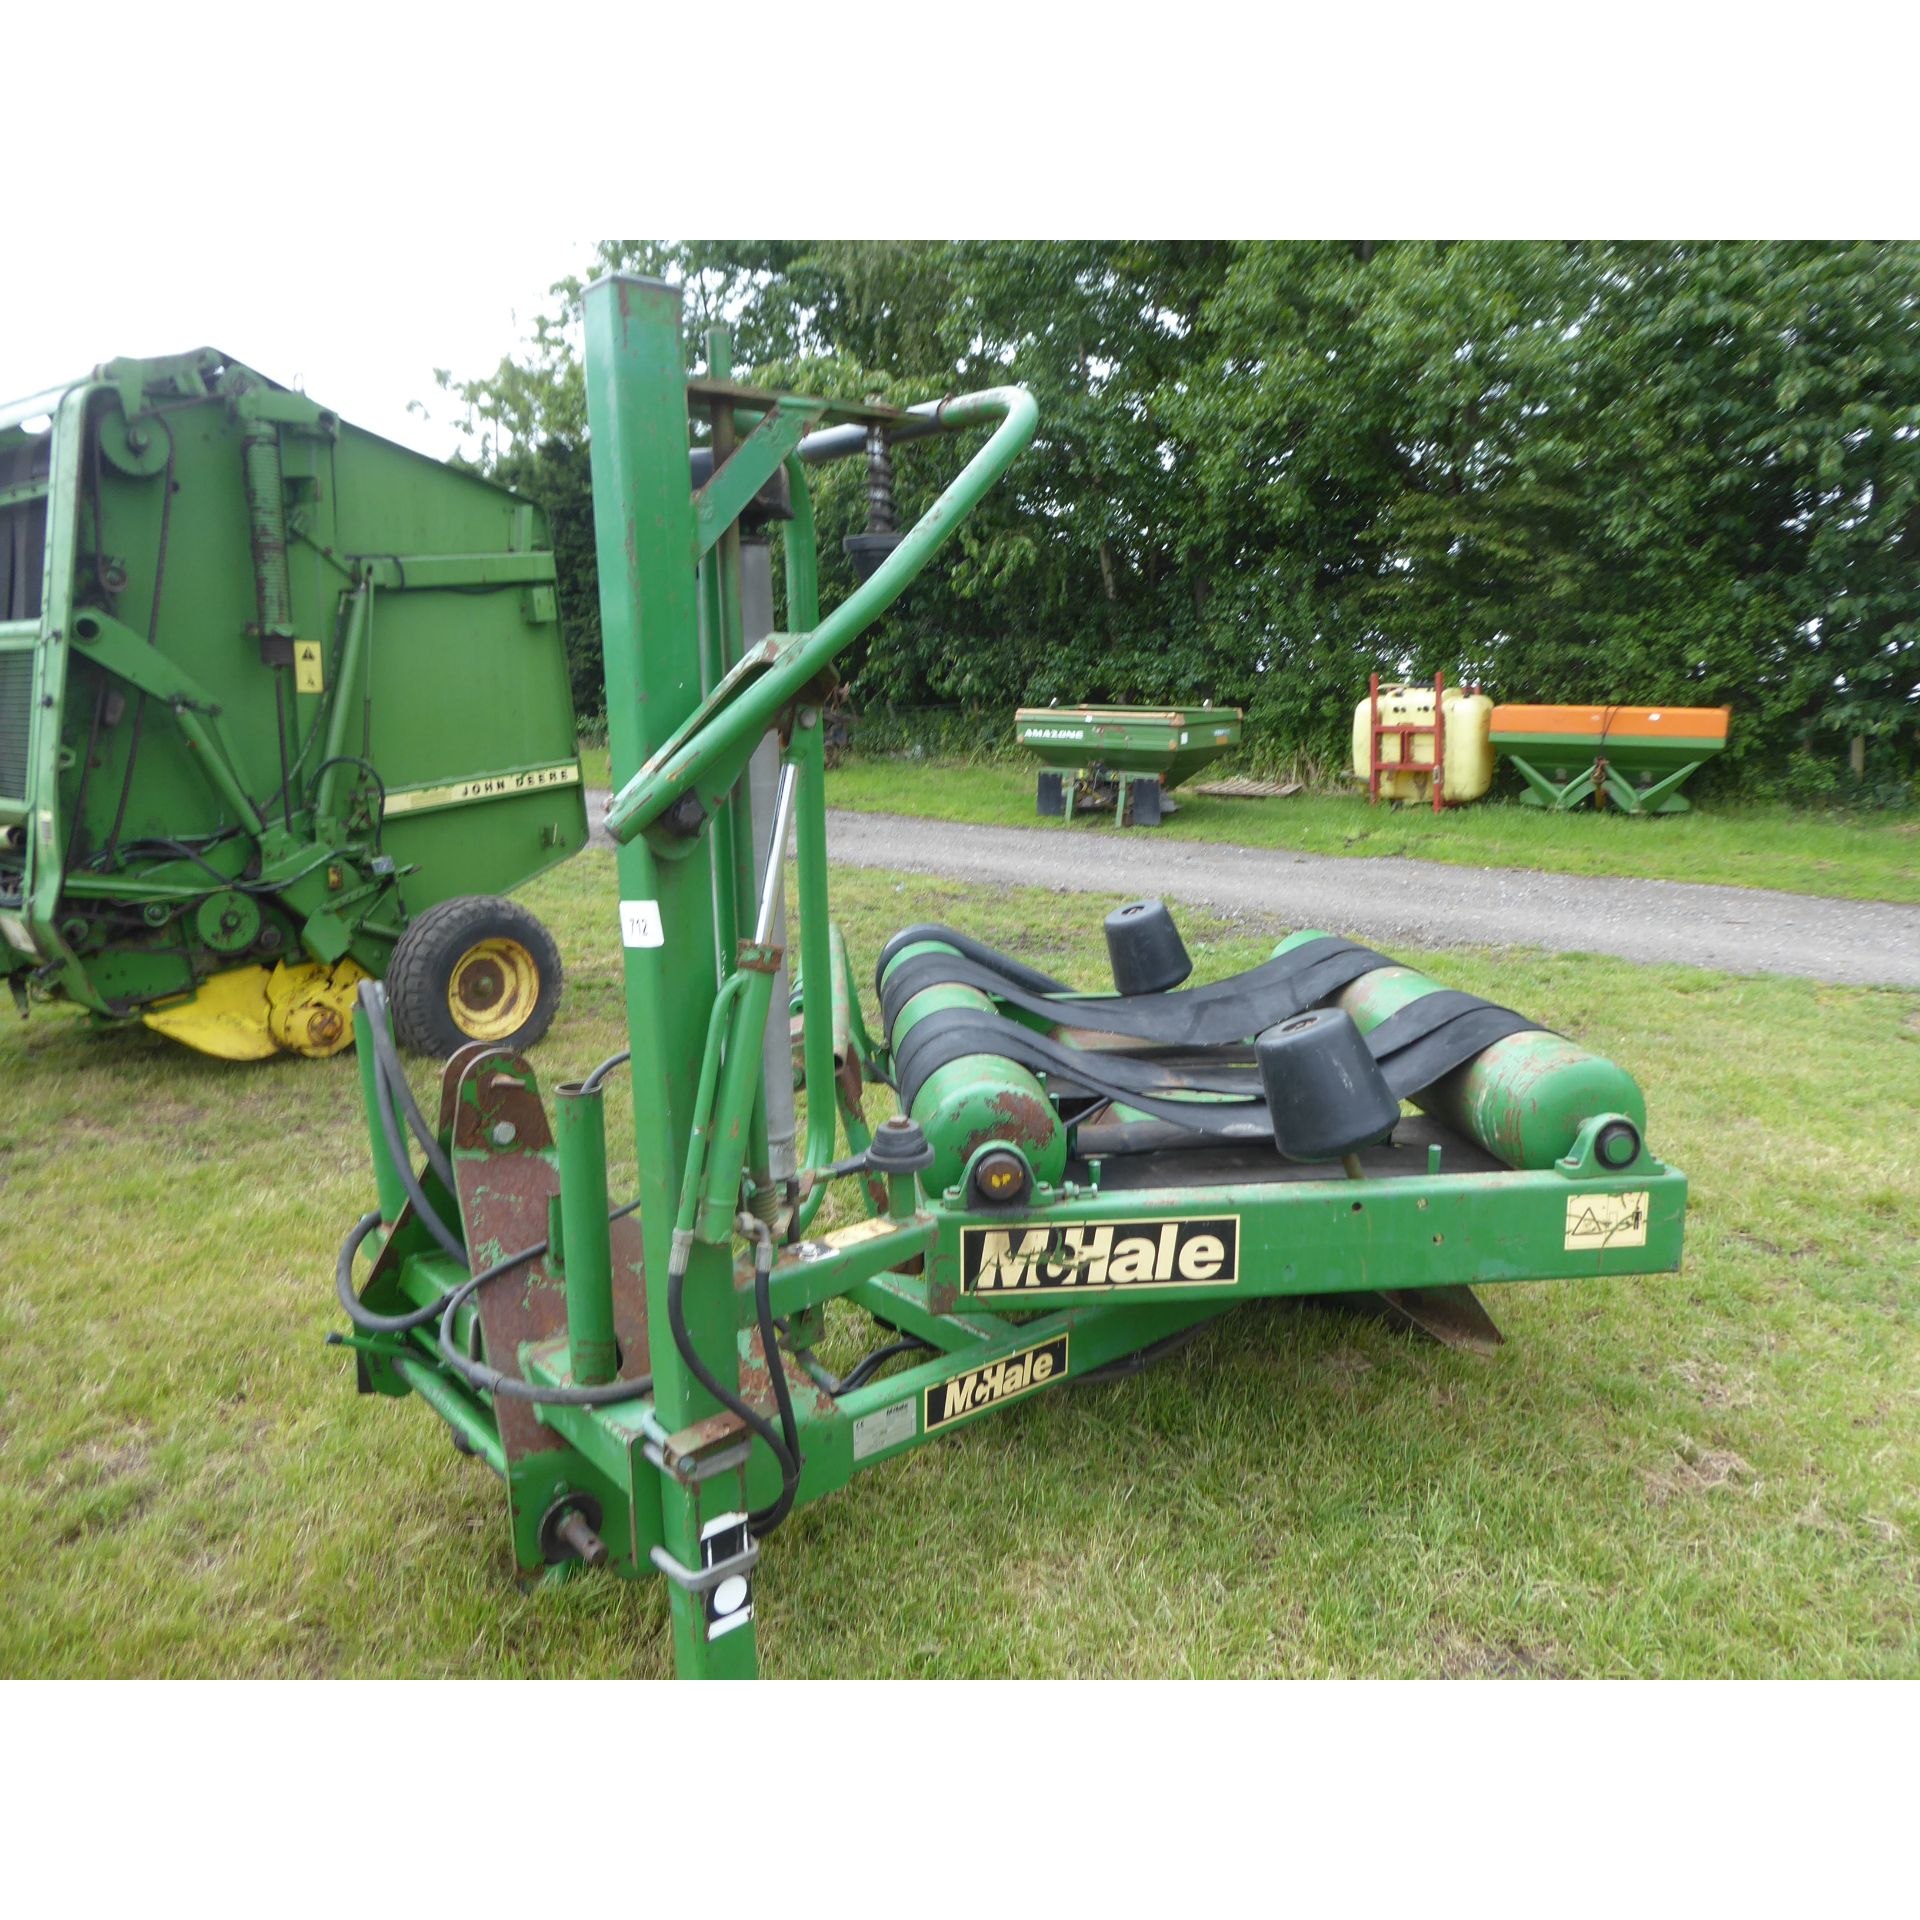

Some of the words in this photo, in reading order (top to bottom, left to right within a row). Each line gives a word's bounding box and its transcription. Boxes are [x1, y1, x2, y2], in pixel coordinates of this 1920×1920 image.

[1024, 728, 1084, 740] AMAZONE
[463, 779, 505, 796] JOHN
[515, 768, 568, 787] DEERE
[976, 1223, 1226, 1289] McHale
[943, 1349, 1054, 1420] McHale
